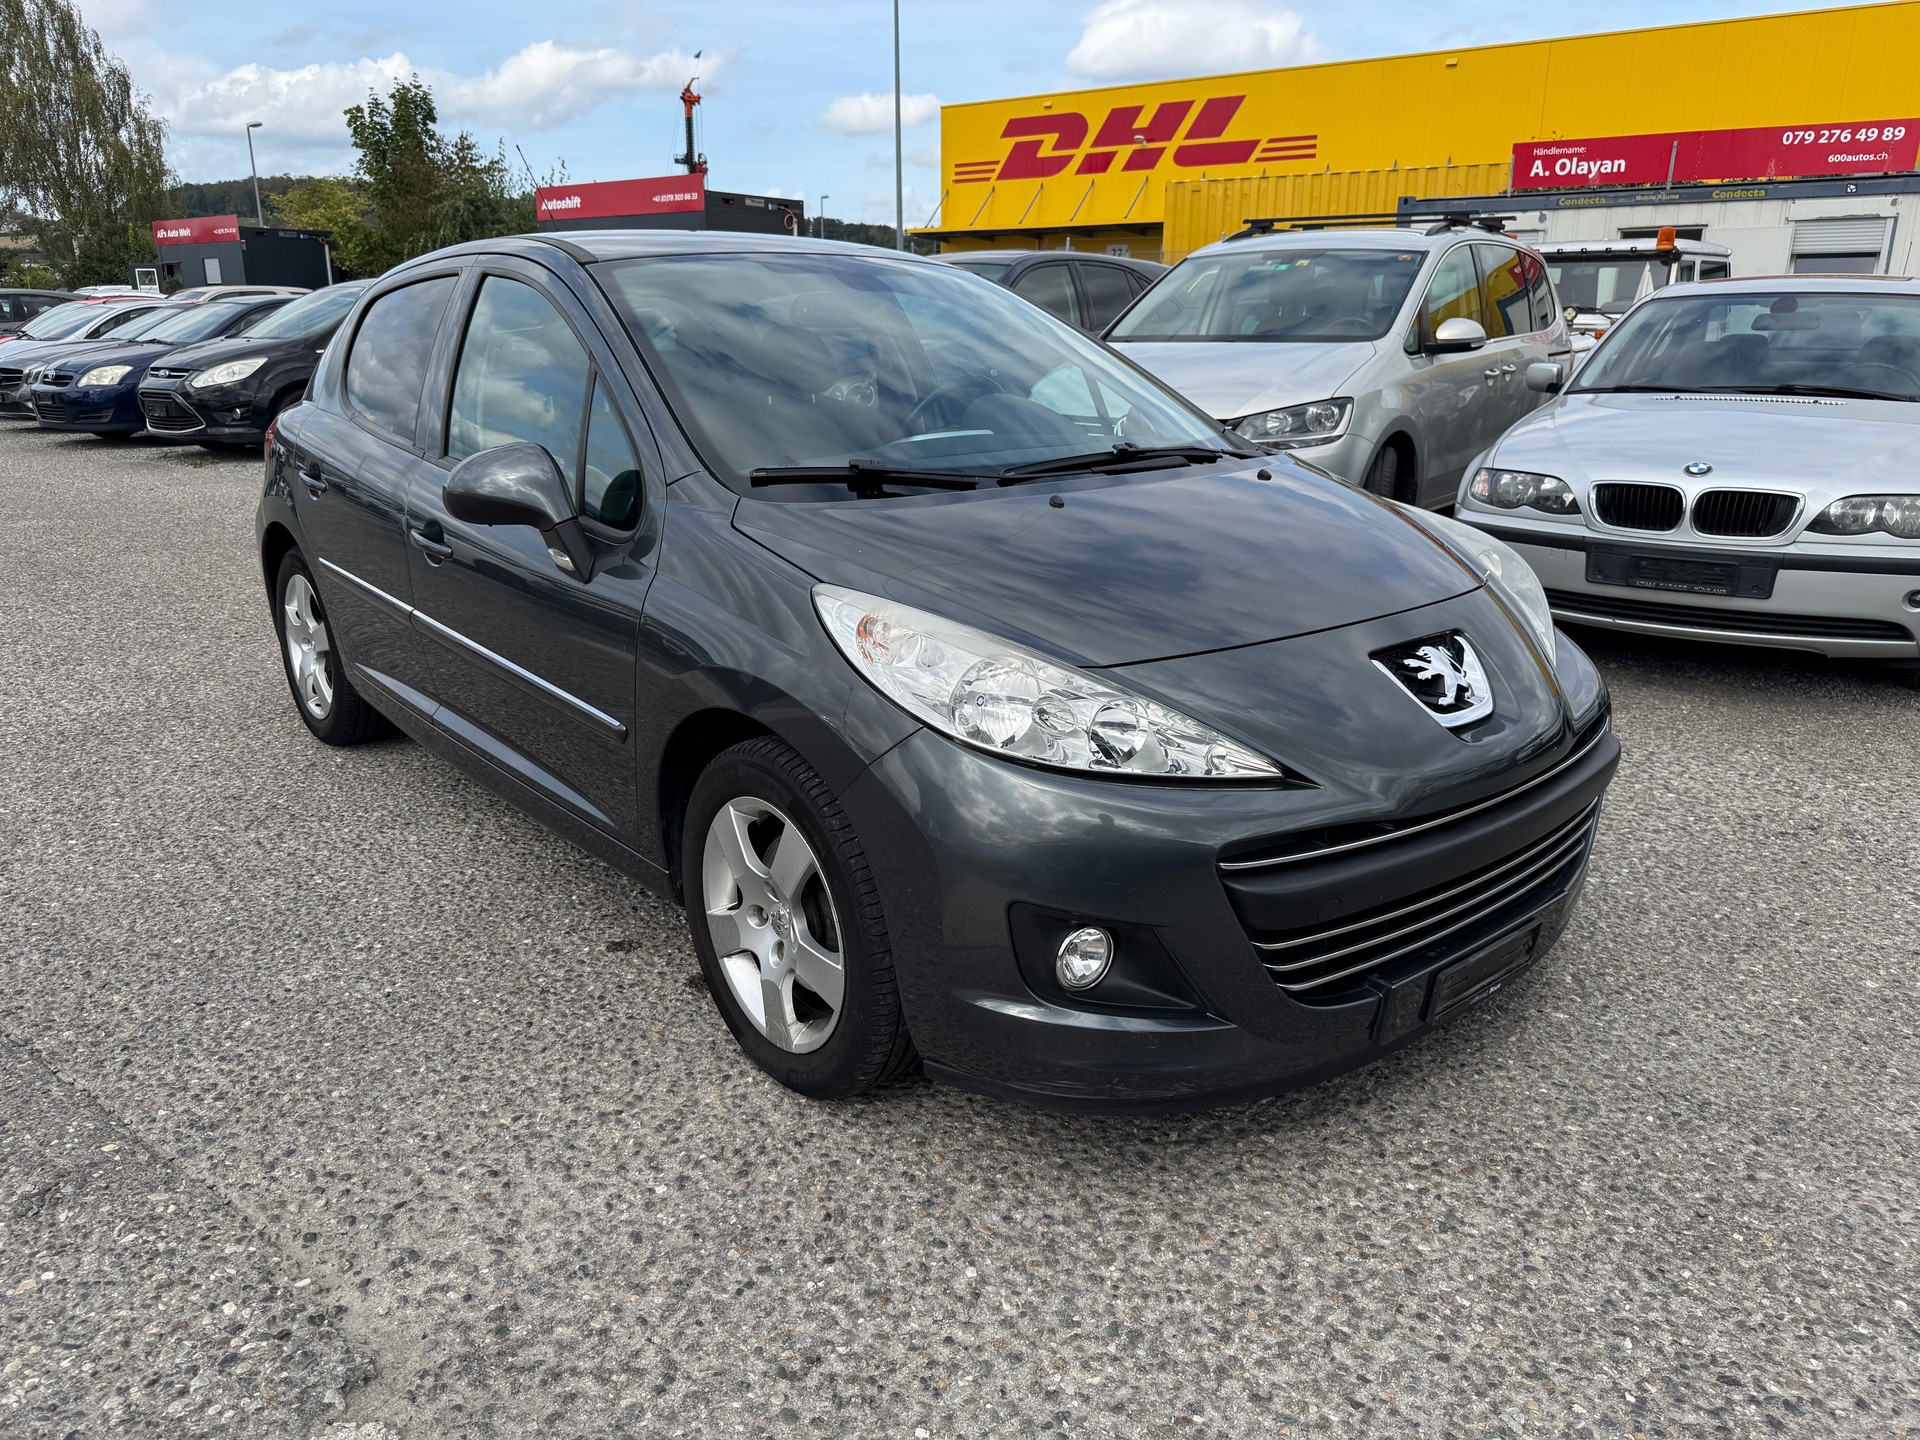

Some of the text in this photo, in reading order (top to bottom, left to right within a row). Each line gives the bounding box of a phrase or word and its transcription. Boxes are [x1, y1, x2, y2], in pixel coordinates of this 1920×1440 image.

[995, 94, 1261, 181] DHL
[1781, 126, 1906, 145] 079 276 49 89
[1533, 146, 1587, 156] Händlername:
[1827, 151, 1888, 163] 600autos.ch
[1529, 157, 1626, 179] A. Olayan
[541, 196, 581, 210] Autoshift
[1558, 196, 1607, 206] Condecta
[1712, 189, 1766, 199] Condecta
